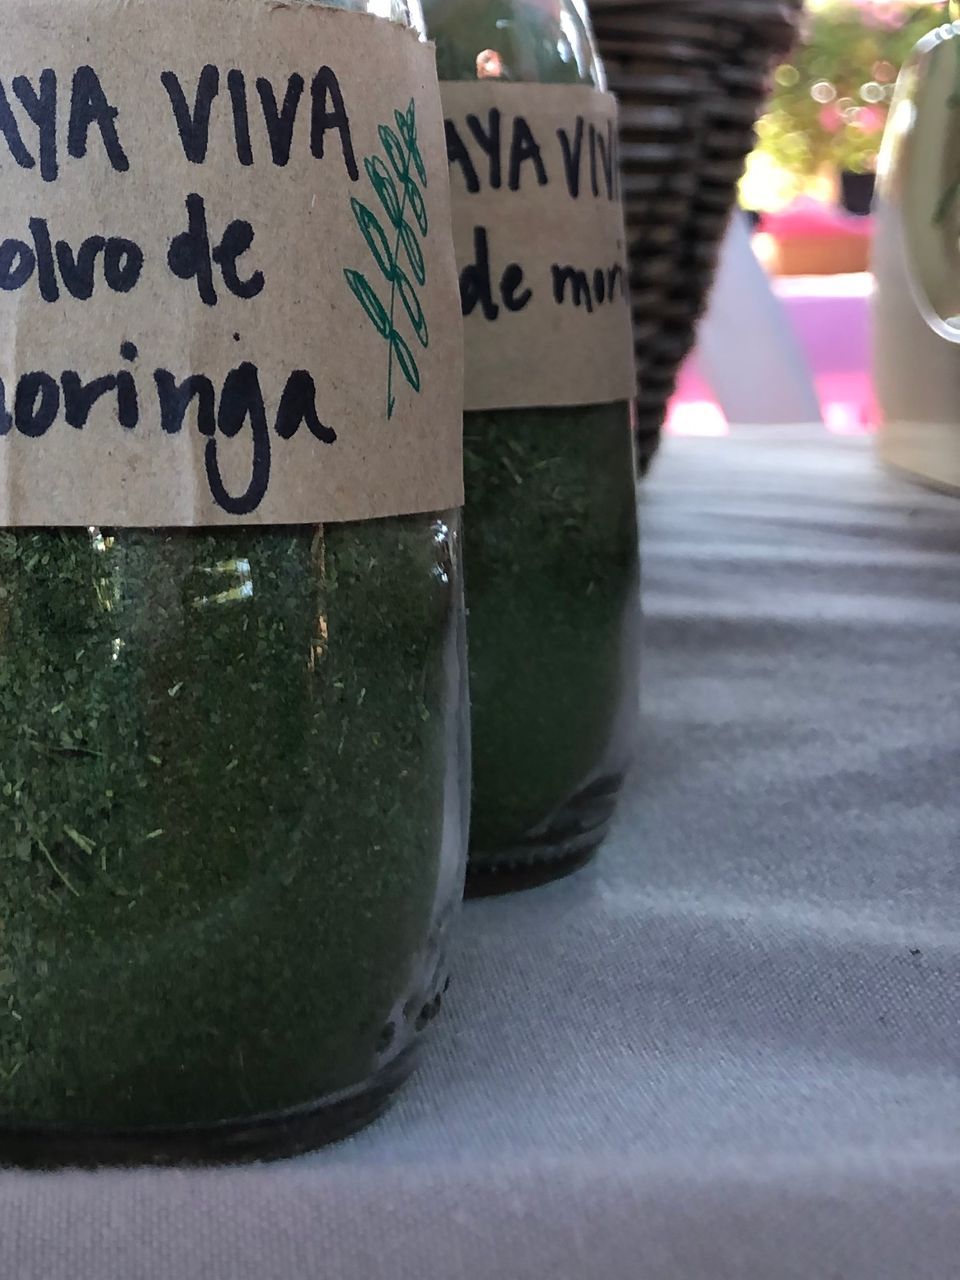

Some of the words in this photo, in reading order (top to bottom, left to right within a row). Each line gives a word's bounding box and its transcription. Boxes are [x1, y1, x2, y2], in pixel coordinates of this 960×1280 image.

[161, 65, 359, 181] VIVA
[167, 193, 265, 305] de
[459, 226, 532, 321] de
